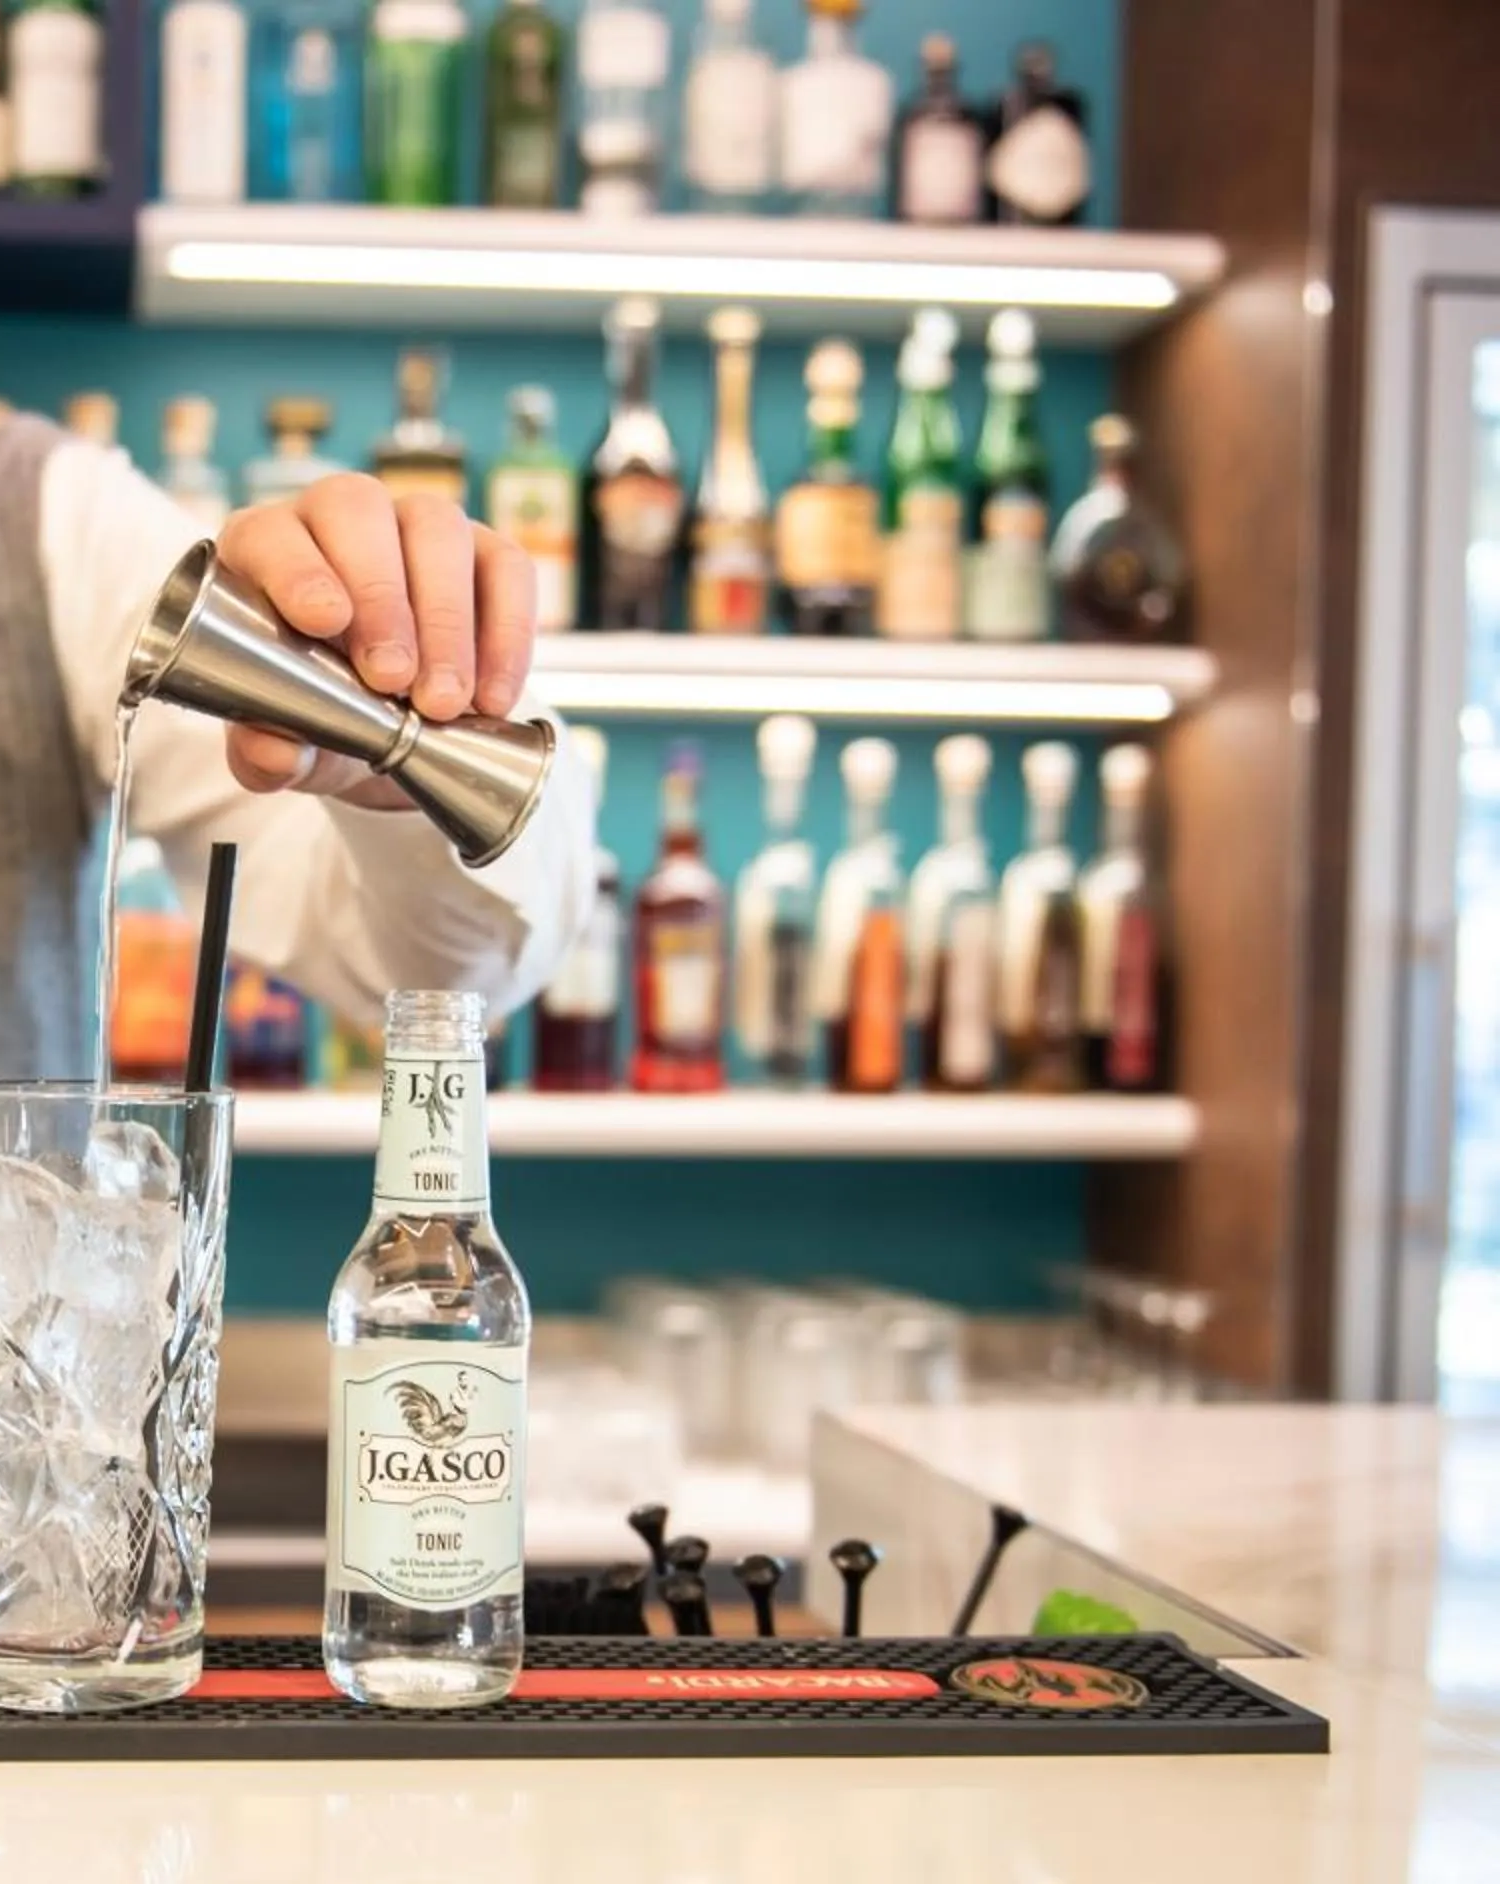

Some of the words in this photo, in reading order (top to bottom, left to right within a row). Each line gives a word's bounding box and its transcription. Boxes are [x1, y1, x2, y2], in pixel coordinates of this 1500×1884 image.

[413, 1171, 460, 1192] TONIC
[367, 1448, 506, 1485] J.GASCO
[415, 1531, 464, 1551] TONIC
